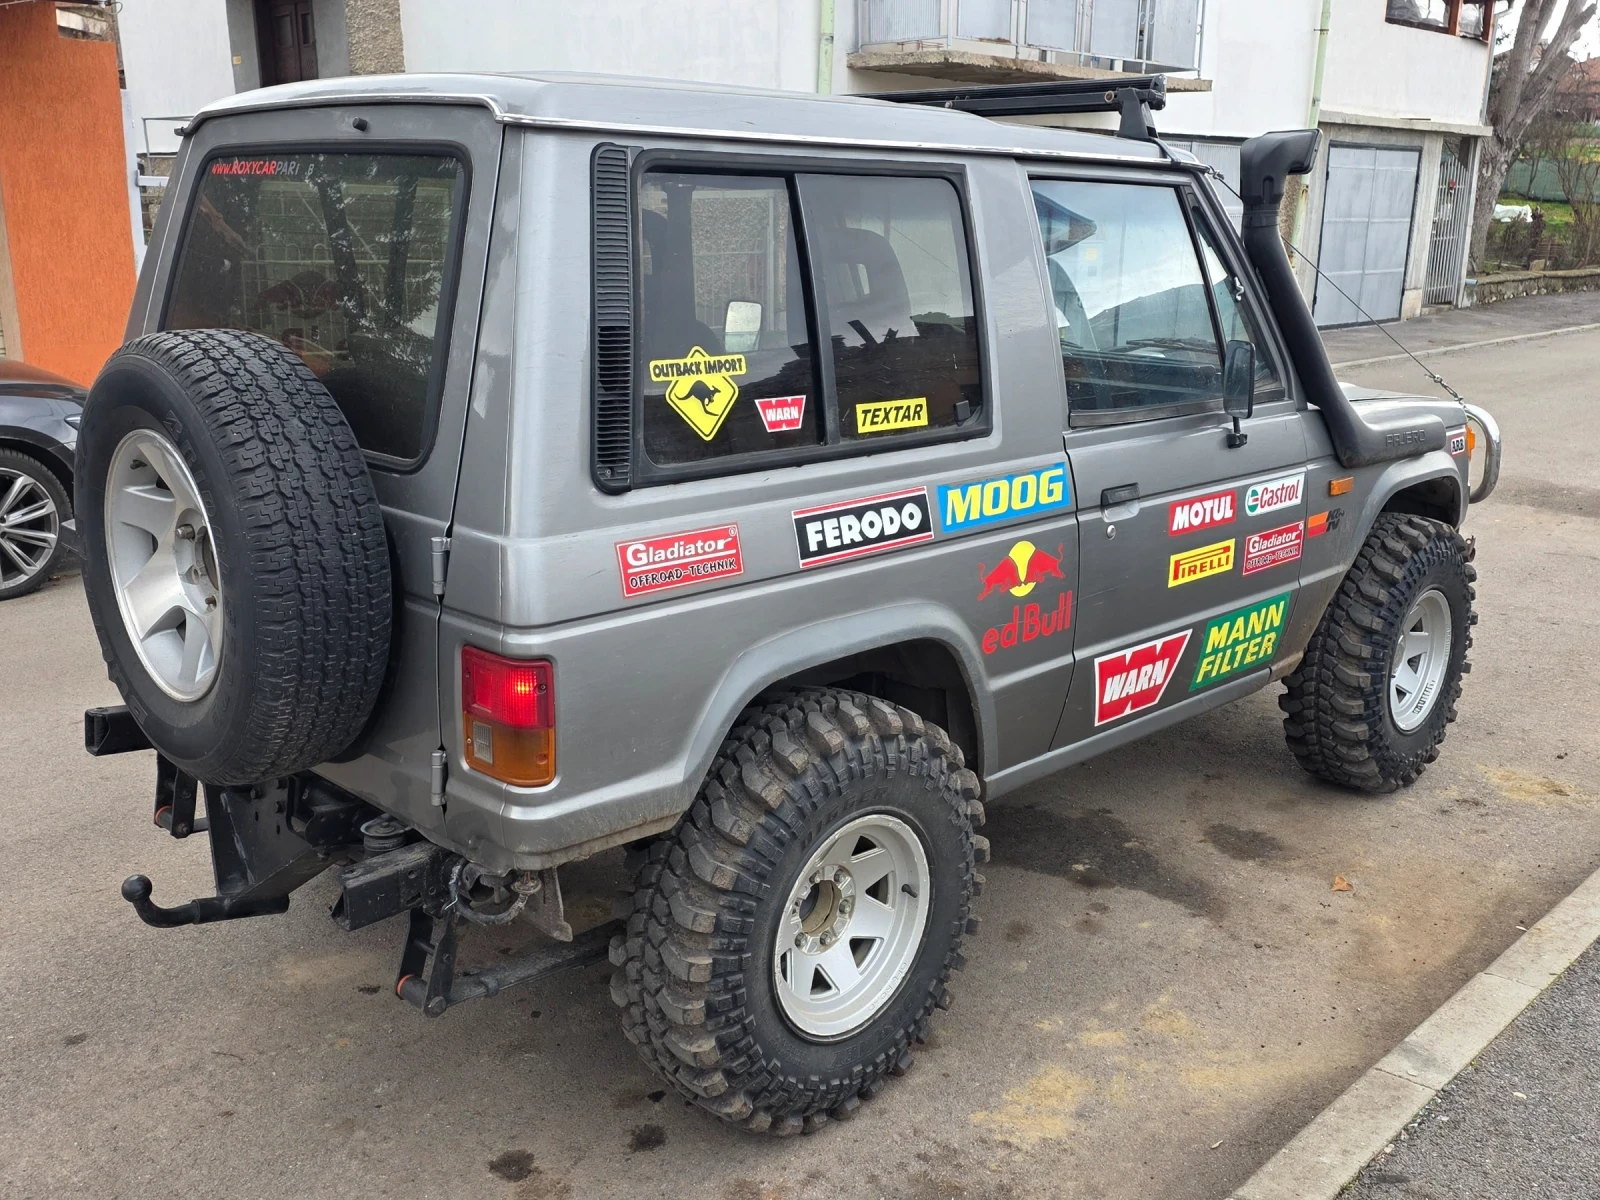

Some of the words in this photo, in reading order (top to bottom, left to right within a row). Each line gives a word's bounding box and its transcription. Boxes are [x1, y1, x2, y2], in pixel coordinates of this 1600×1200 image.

[652, 362, 702, 378] OUTBACK
[704, 358, 743, 374] IMPORT
[766, 407, 799, 421] WARN
[860, 404, 924, 427] TEXTAR
[946, 469, 1063, 525] MOOG
[1260, 479, 1300, 509] Castrol
[806, 503, 922, 552] FERODO
[1171, 495, 1233, 531] MOTUL
[626, 537, 732, 567] Gladiator
[1249, 530, 1300, 553] Gladiator
[630, 558, 737, 588] OFFROAD-TECHNIK
[1173, 545, 1231, 581] PIRELLI
[1023, 590, 1073, 642] Bull
[1206, 601, 1285, 653] MANN
[1196, 632, 1277, 683] FILTER
[1102, 657, 1170, 703] WARN
